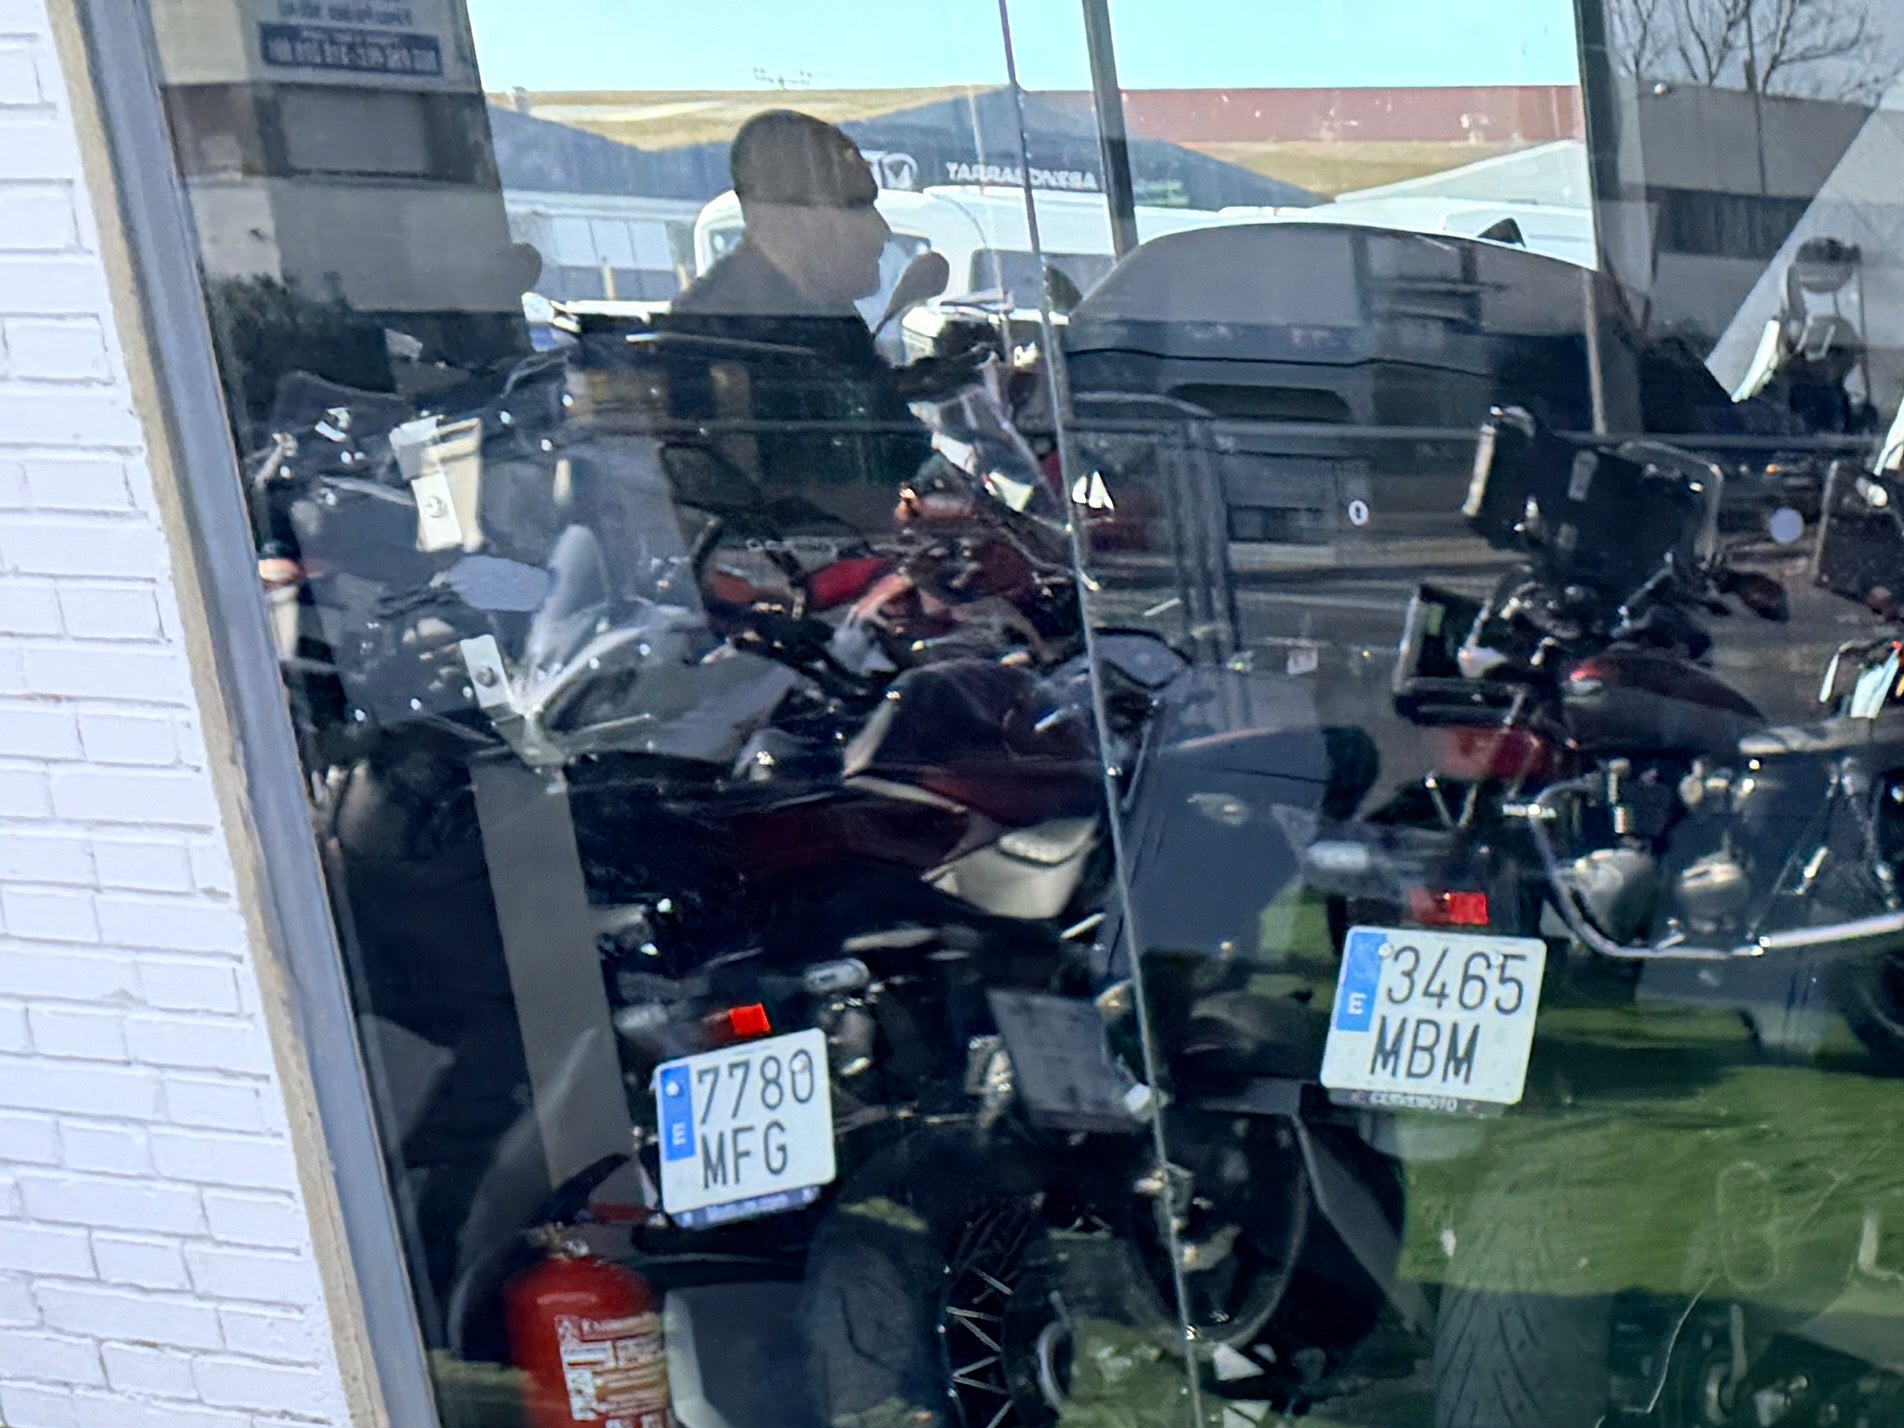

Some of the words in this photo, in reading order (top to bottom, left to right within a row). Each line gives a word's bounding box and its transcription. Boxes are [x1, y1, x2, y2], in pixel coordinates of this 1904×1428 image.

[1347, 992, 1367, 1016] E
[1386, 945, 1528, 1016] 3465
[1369, 1014, 1481, 1086] MBM
[697, 1048, 815, 1126] 7780
[701, 1120, 789, 1190] MFG
